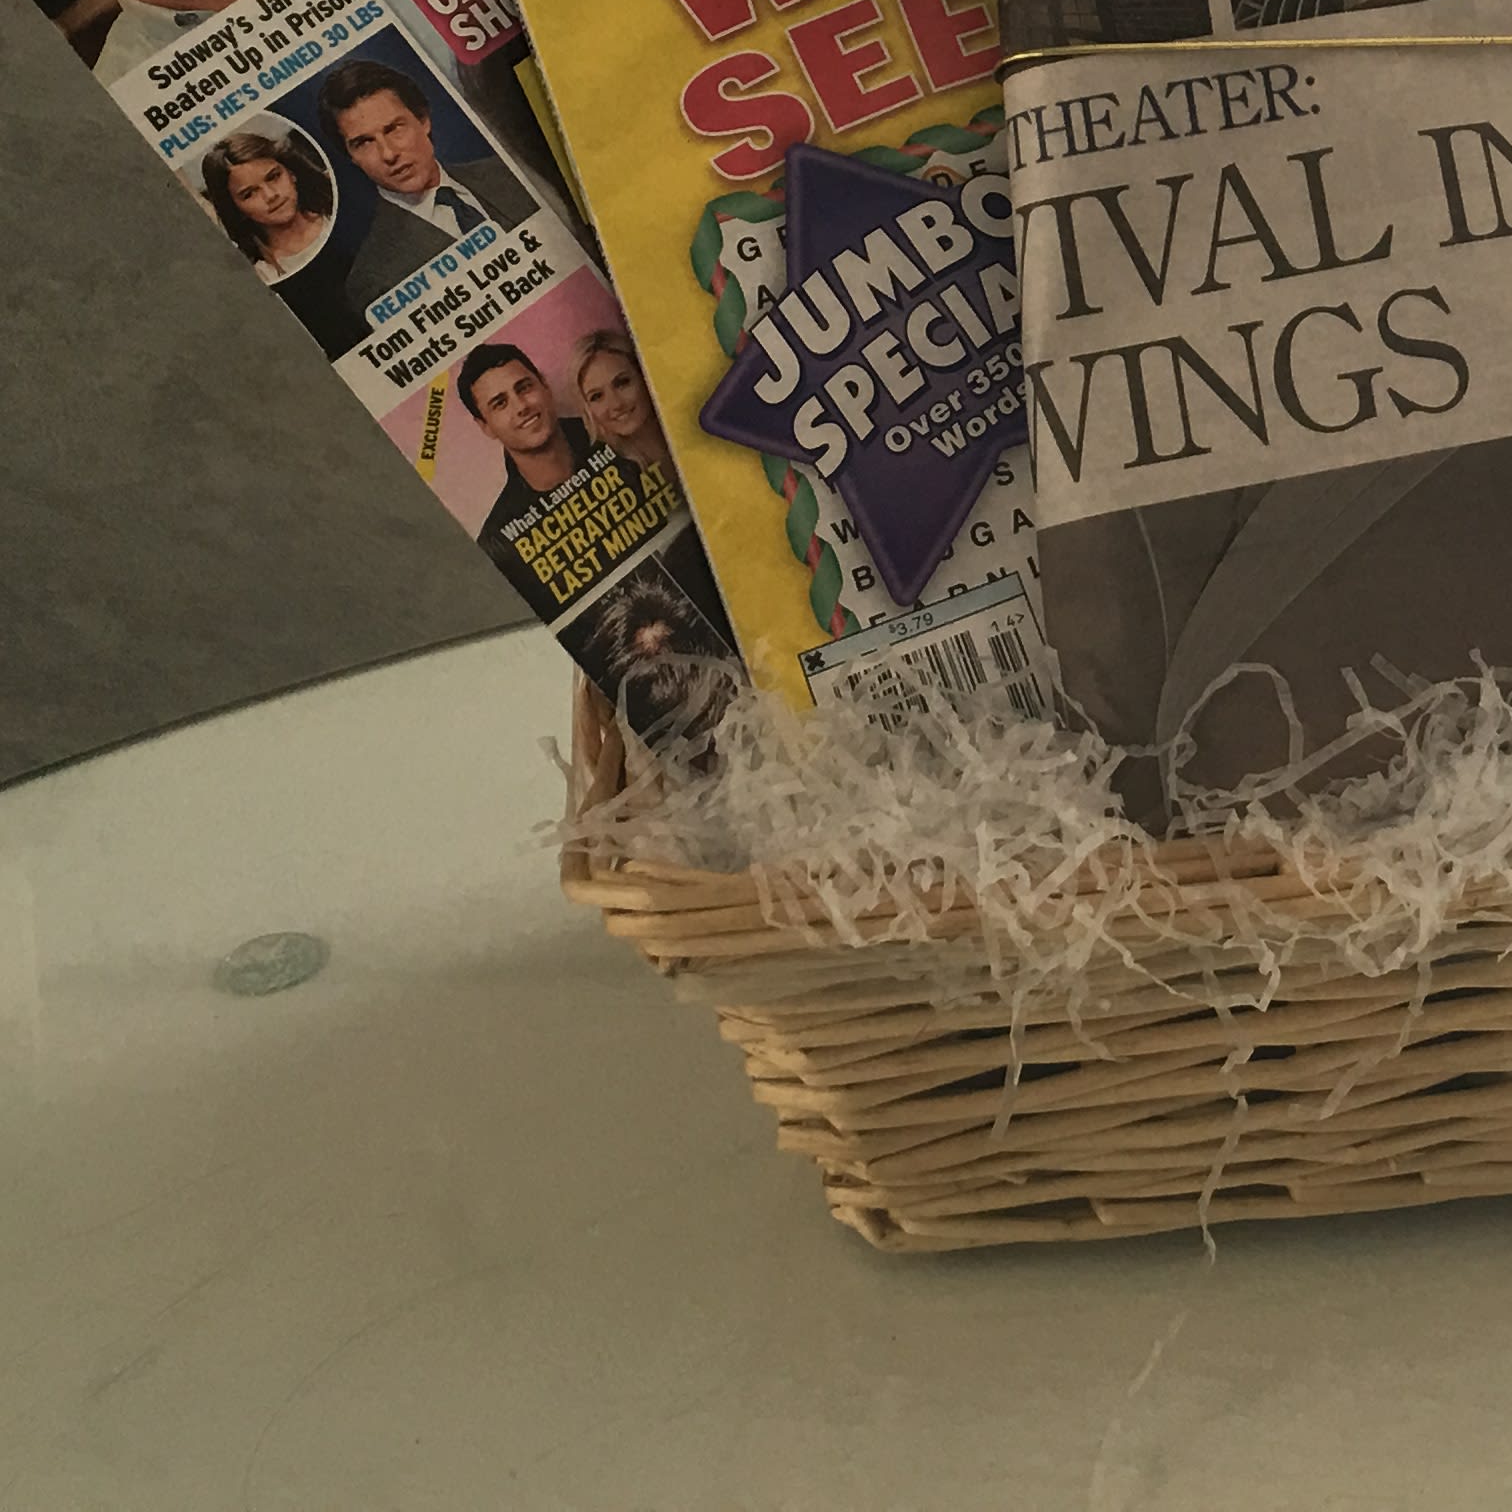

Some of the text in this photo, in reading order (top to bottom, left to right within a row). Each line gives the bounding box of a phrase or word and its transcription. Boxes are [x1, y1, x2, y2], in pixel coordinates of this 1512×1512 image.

[143, 69, 231, 133] Beaten
[229, 47, 265, 76] Up
[266, 24, 290, 54] in
[147, 15, 254, 90] Subway's
[158, 0, 385, 159] PLUS: HE'S GAINED 30 LBS
[1006, 63, 1322, 172] THEATER:
[358, 228, 543, 370] Tom Finds Love &
[370, 224, 498, 325] READY TO WED
[384, 257, 557, 390] Wants Suri Back
[751, 172, 1014, 406] JUMBO
[420, 386, 446, 462] EXCLUSIVE
[884, 390, 963, 453] Over
[501, 444, 618, 542] What Lauren Hid
[514, 464, 626, 565] BACHELOR
[531, 460, 670, 585] BETRAYED AT
[550, 485, 682, 606] LAST MINUTE
[889, 612, 934, 636] $3.79
